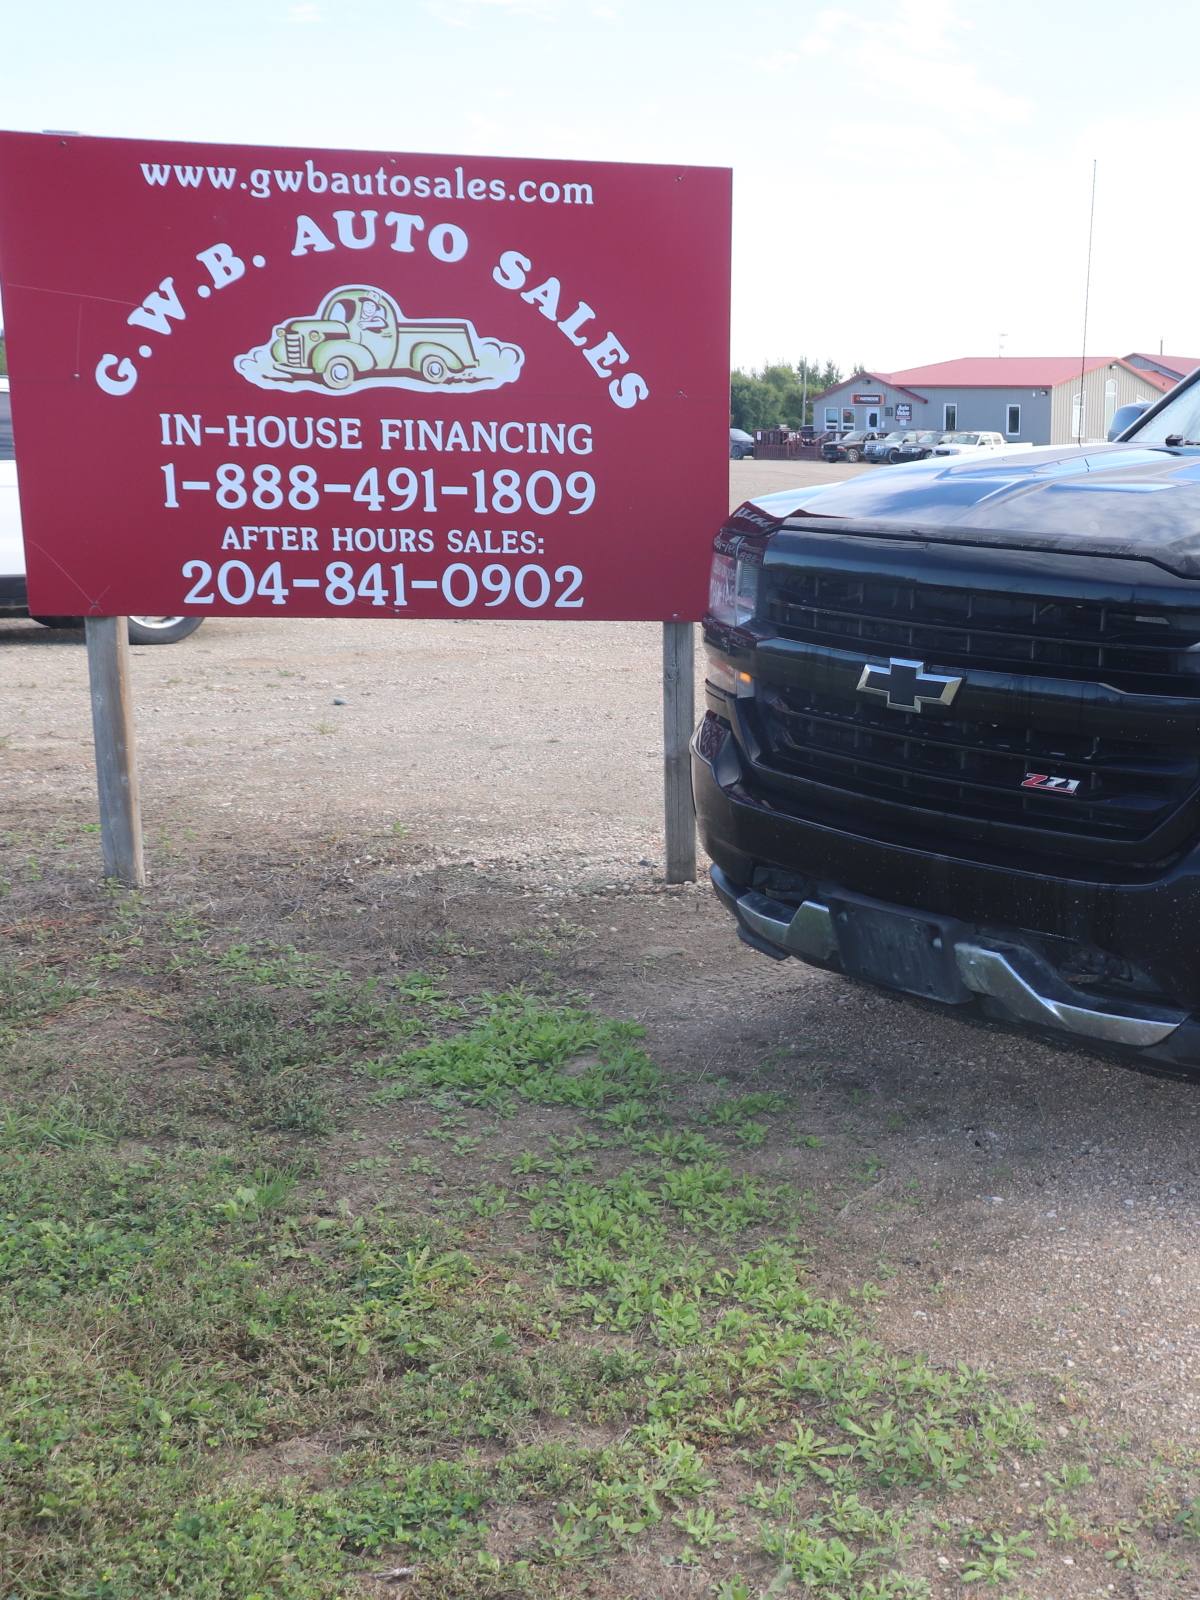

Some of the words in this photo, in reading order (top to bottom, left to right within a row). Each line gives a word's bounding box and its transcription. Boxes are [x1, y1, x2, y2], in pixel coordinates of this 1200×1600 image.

[140, 160, 593, 204] www.gwbautosales.com
[96, 243, 266, 395] G.W.B.
[291, 210, 468, 262] AUTO
[493, 251, 649, 408] SALES
[160, 413, 363, 450] IN-HOUSE
[380, 418, 593, 455] FINANCING
[161, 463, 596, 515] 1-888-491-1809
[221, 526, 319, 551] AFTER
[332, 528, 434, 553] HOURS
[448, 530, 545, 555] SALES:
[182, 560, 585, 608] 204-841-0902
[1021, 773, 1080, 793] Z71
